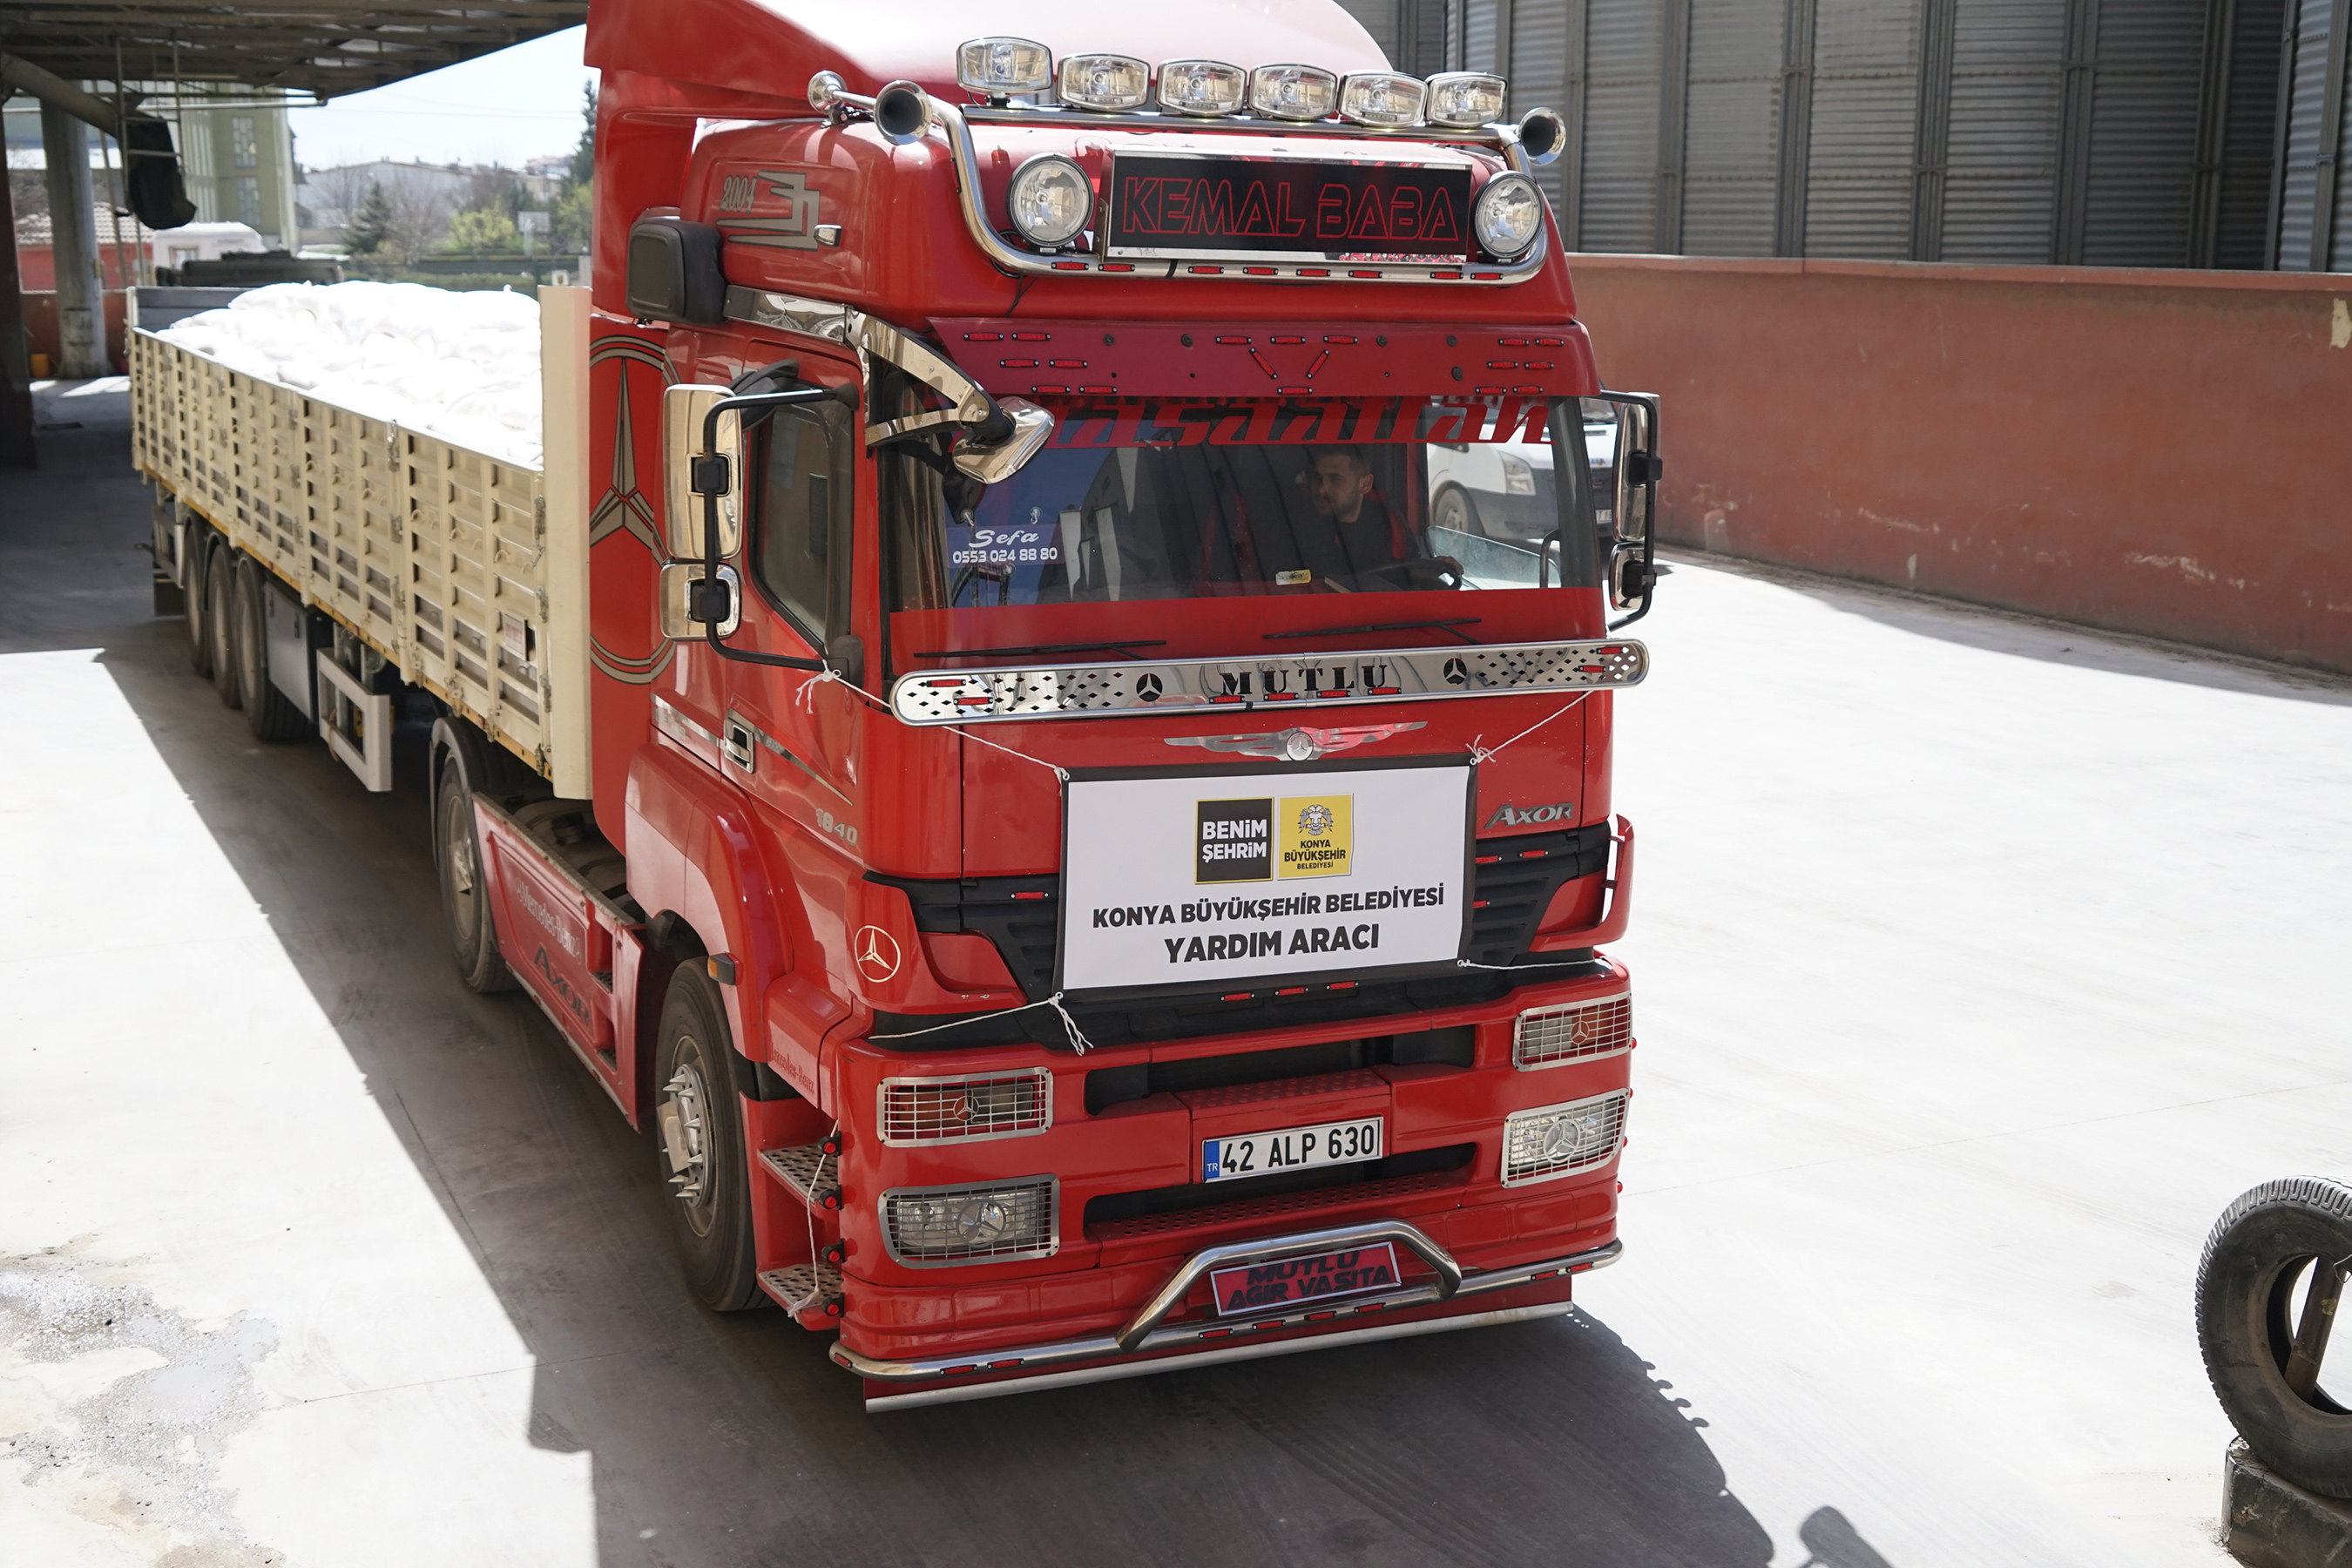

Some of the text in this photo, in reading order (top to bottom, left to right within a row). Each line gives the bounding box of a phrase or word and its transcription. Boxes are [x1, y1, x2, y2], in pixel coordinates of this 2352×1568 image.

[1122, 176, 1459, 241] KEMAL BABA
[969, 529, 1039, 548] Sefa
[952, 547, 1058, 564] 0553 024 88 80
[1220, 665, 1389, 695] MUTLU
[815, 808, 858, 846] 1840
[1284, 848, 1346, 863] BÜYÜKŞEHİR
[1300, 839, 1331, 849] KONYA
[1297, 860, 1334, 869] BELEDİYESİ
[1092, 882, 1444, 929] KONYA BÜYÜKŞEHİR BELEDİYESİ
[1165, 923, 1380, 963] YARDIM ARACI
[1206, 1125, 1375, 1173] TR 42 ALP 630
[1247, 1250, 1361, 1285] MUTLU
[1297, 1265, 1392, 1296] VASITA
